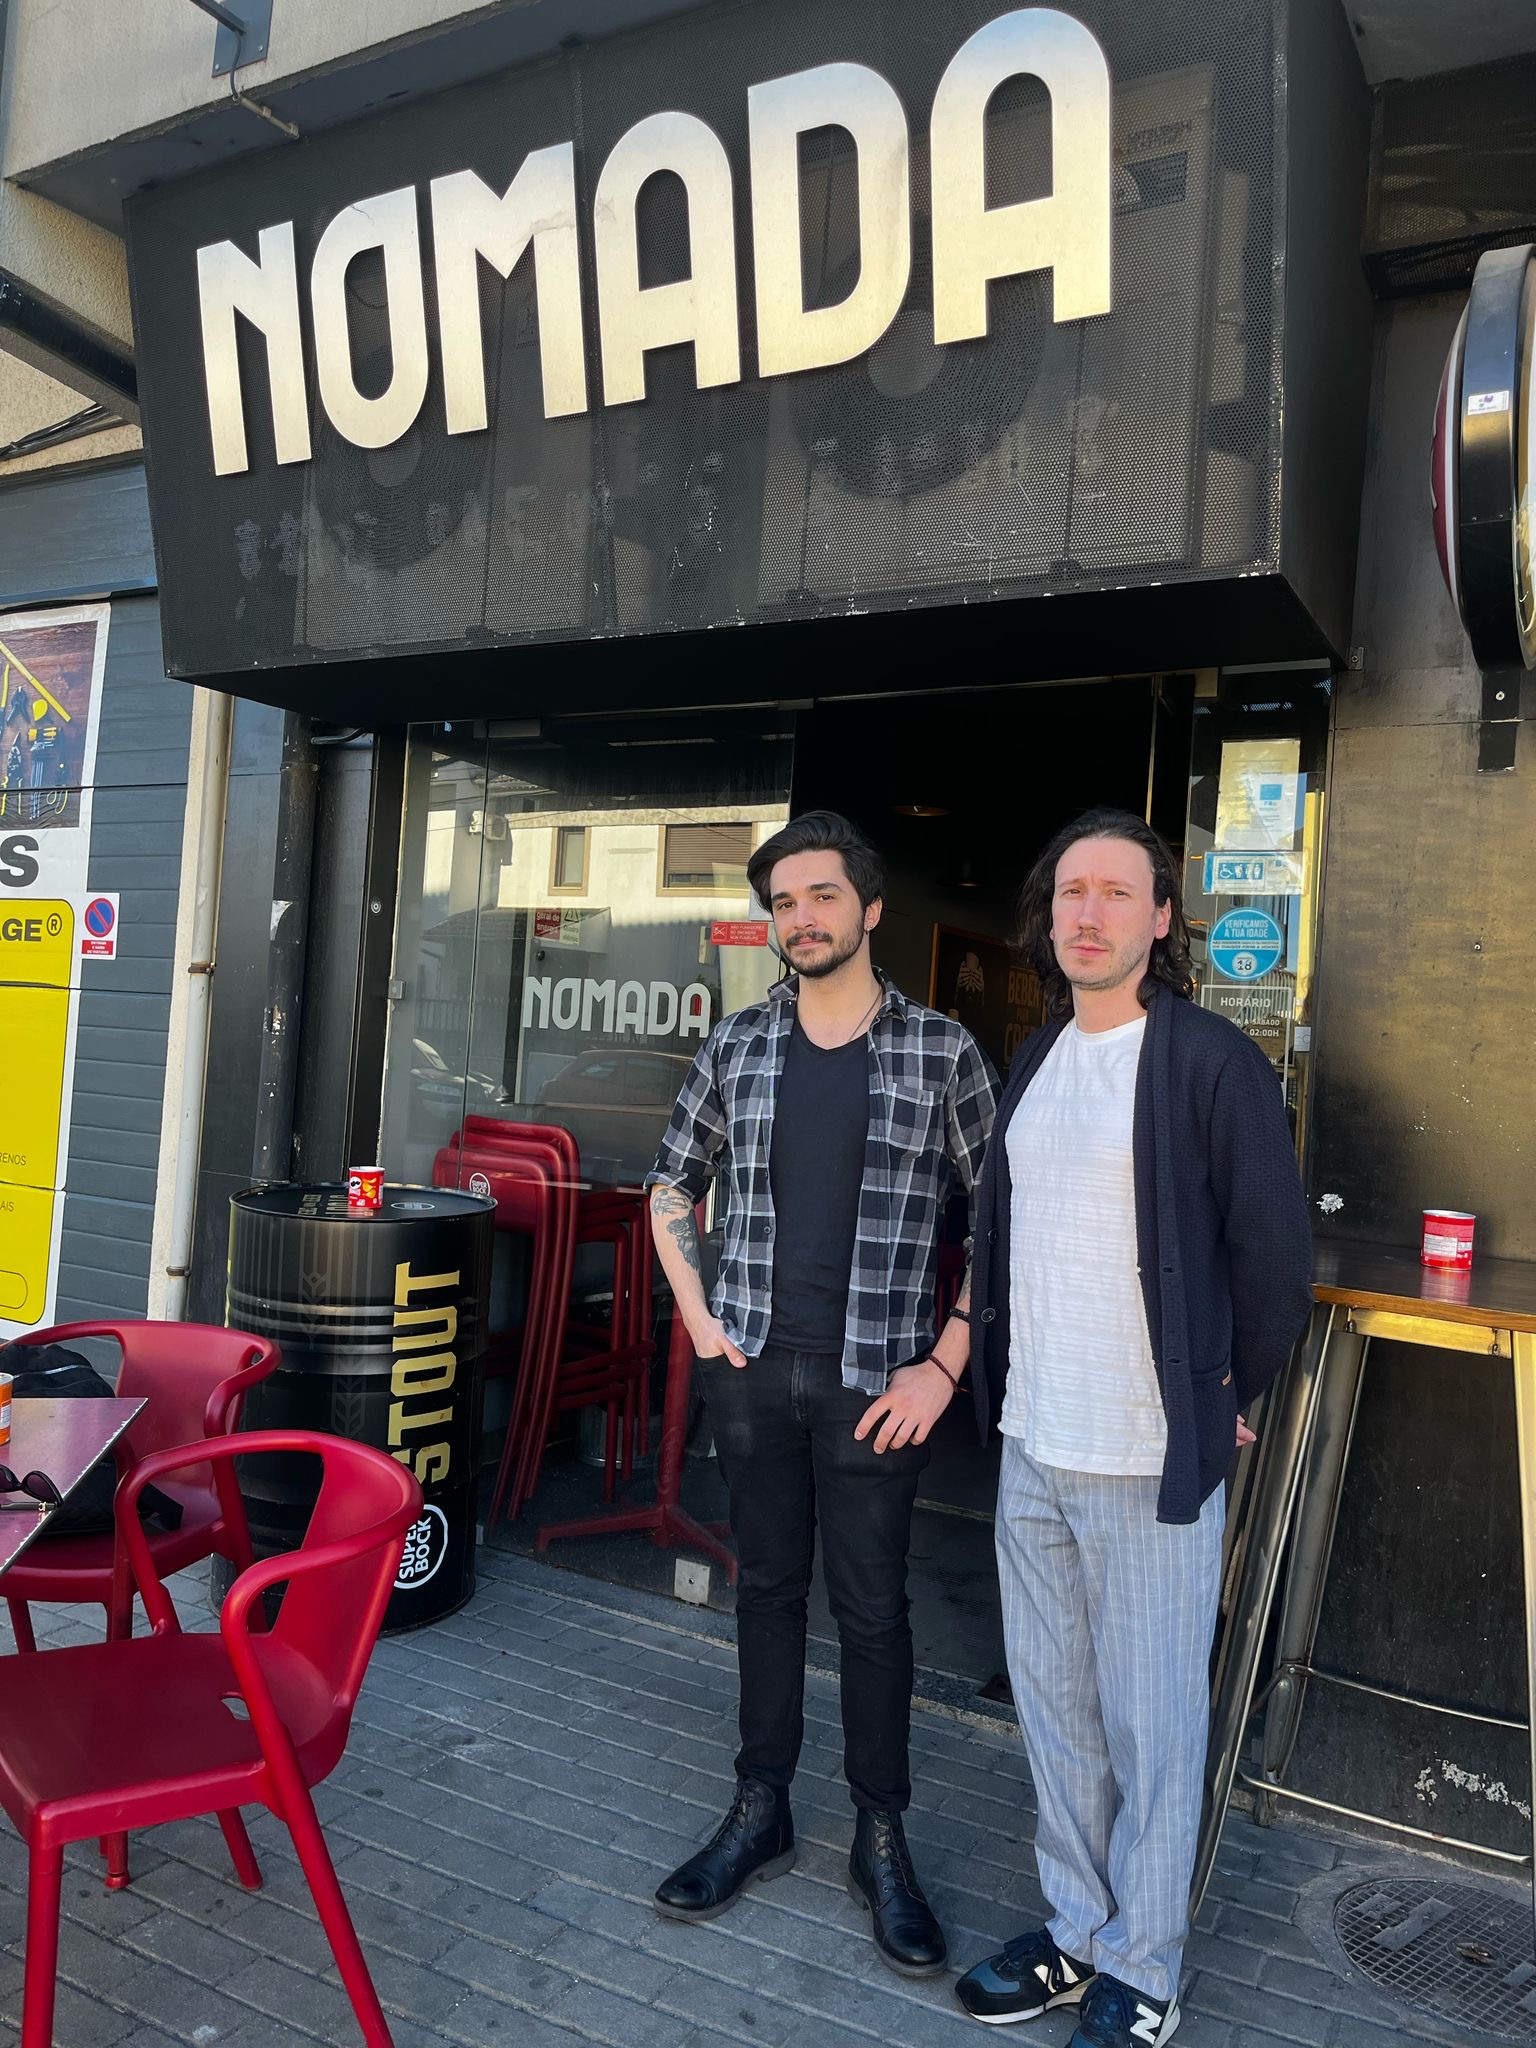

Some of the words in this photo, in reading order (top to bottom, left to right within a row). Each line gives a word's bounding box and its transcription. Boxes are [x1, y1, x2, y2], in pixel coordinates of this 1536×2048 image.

[197, 7, 1112, 476] NOMADA
[1224, 920, 1269, 929] VERIFICAMOS
[1224, 928, 1230, 937] A
[1231, 928, 1245, 937] TUA
[1246, 928, 1269, 938] IDADE
[522, 976, 711, 1038] NOMADA
[1220, 995, 1271, 1008] HORÁRIO
[1249, 1029, 1279, 1037] 02:00H
[0, 1200, 15, 1212] AIS
[387, 1262, 460, 1486] STOUT
[415, 1515, 432, 1573] BOCK
